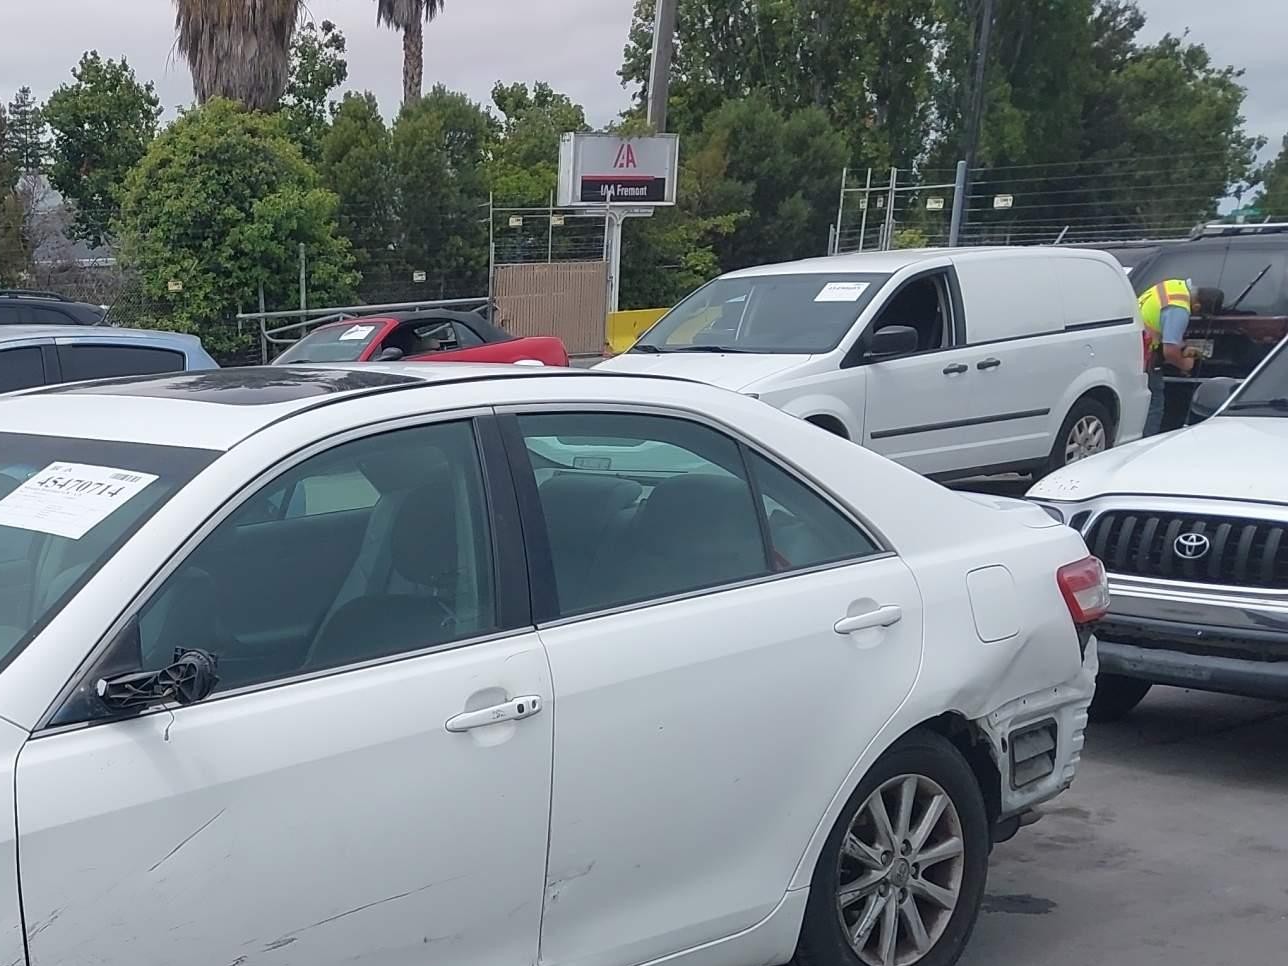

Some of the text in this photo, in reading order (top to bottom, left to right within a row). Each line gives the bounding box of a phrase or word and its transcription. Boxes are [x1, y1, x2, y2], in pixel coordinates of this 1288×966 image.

[600, 184, 647, 196] IAA Fremont
[37, 476, 126, 497] 45470714
